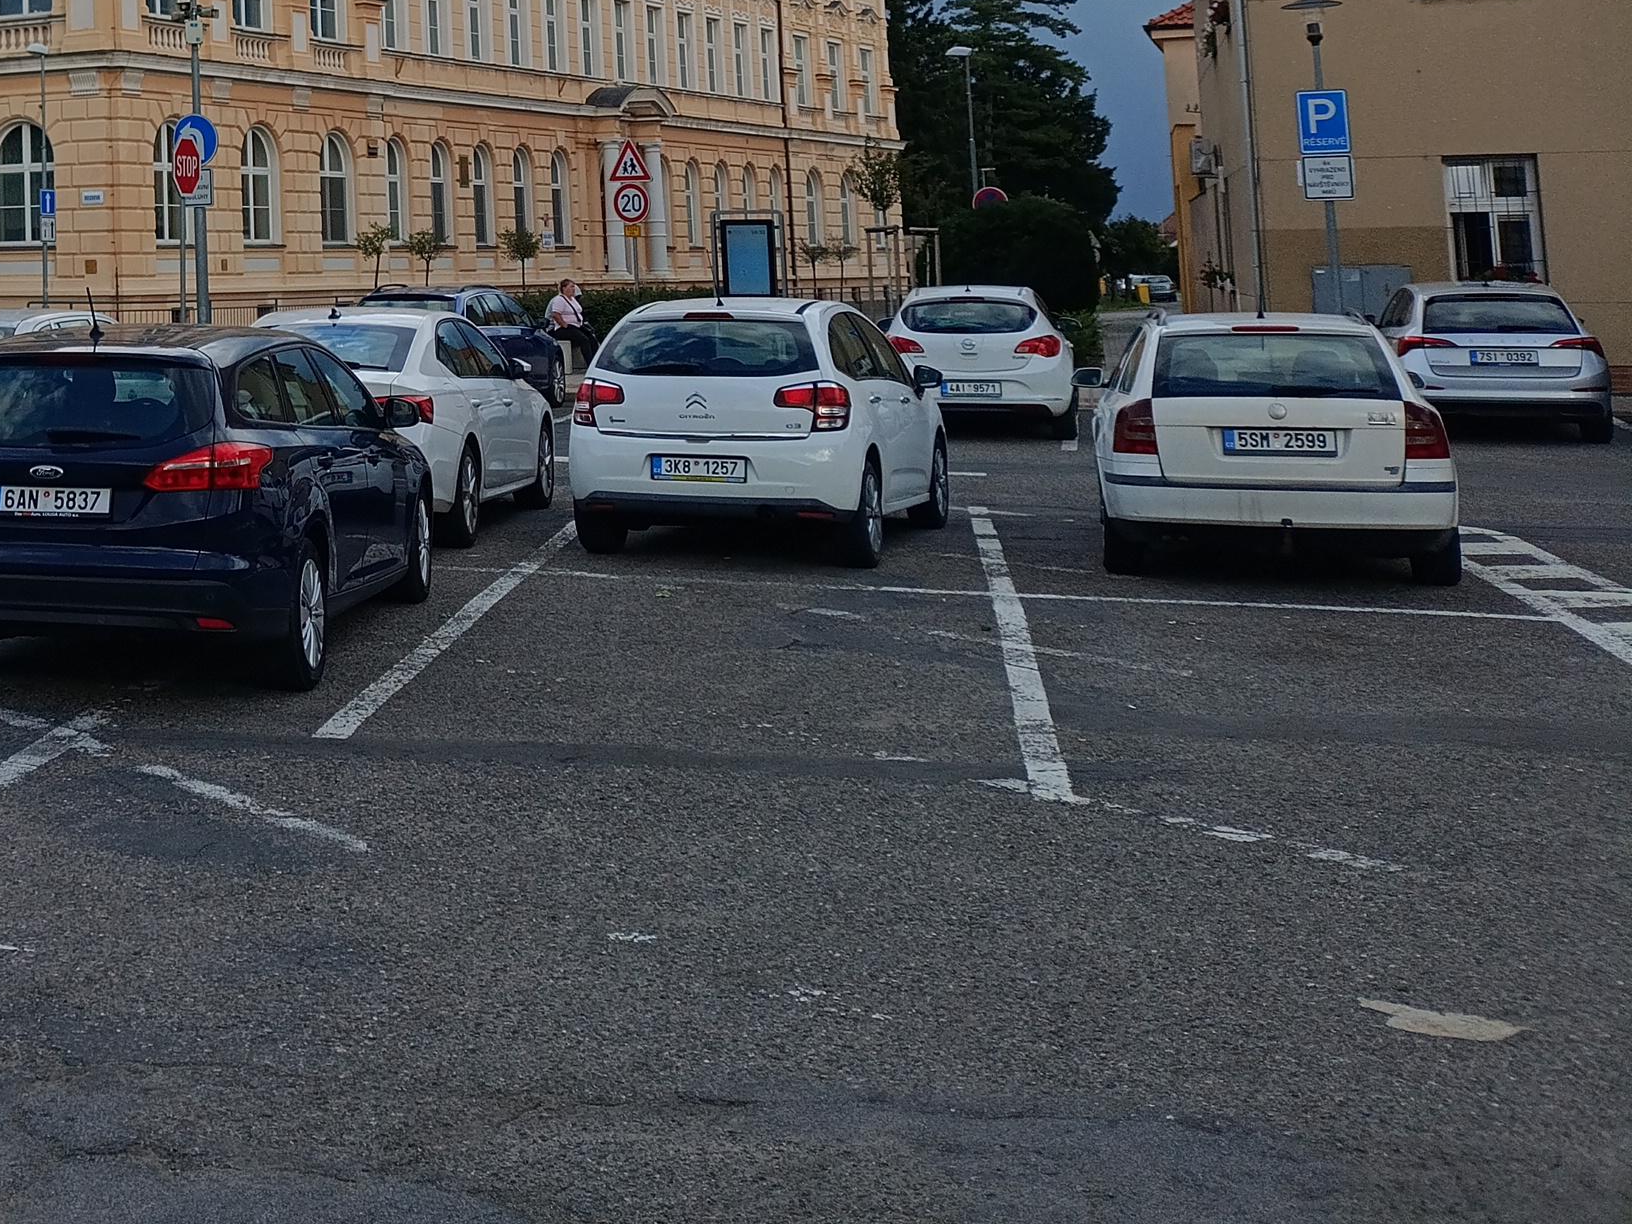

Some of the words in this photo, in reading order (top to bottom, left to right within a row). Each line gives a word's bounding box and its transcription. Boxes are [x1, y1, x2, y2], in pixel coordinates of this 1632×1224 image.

[1307, 98, 1337, 134] P
[176, 155, 198, 177] STOP
[620, 193, 642, 212] 20
[1506, 352, 1533, 362] 0392
[972, 382, 996, 393] 9571
[1238, 432, 1270, 448] 5SM
[1283, 433, 1328, 449] 2599
[664, 459, 691, 474] 3K8
[703, 460, 738, 476] 1257
[4, 488, 40, 510] 6AN
[54, 489, 101, 511] 5837
